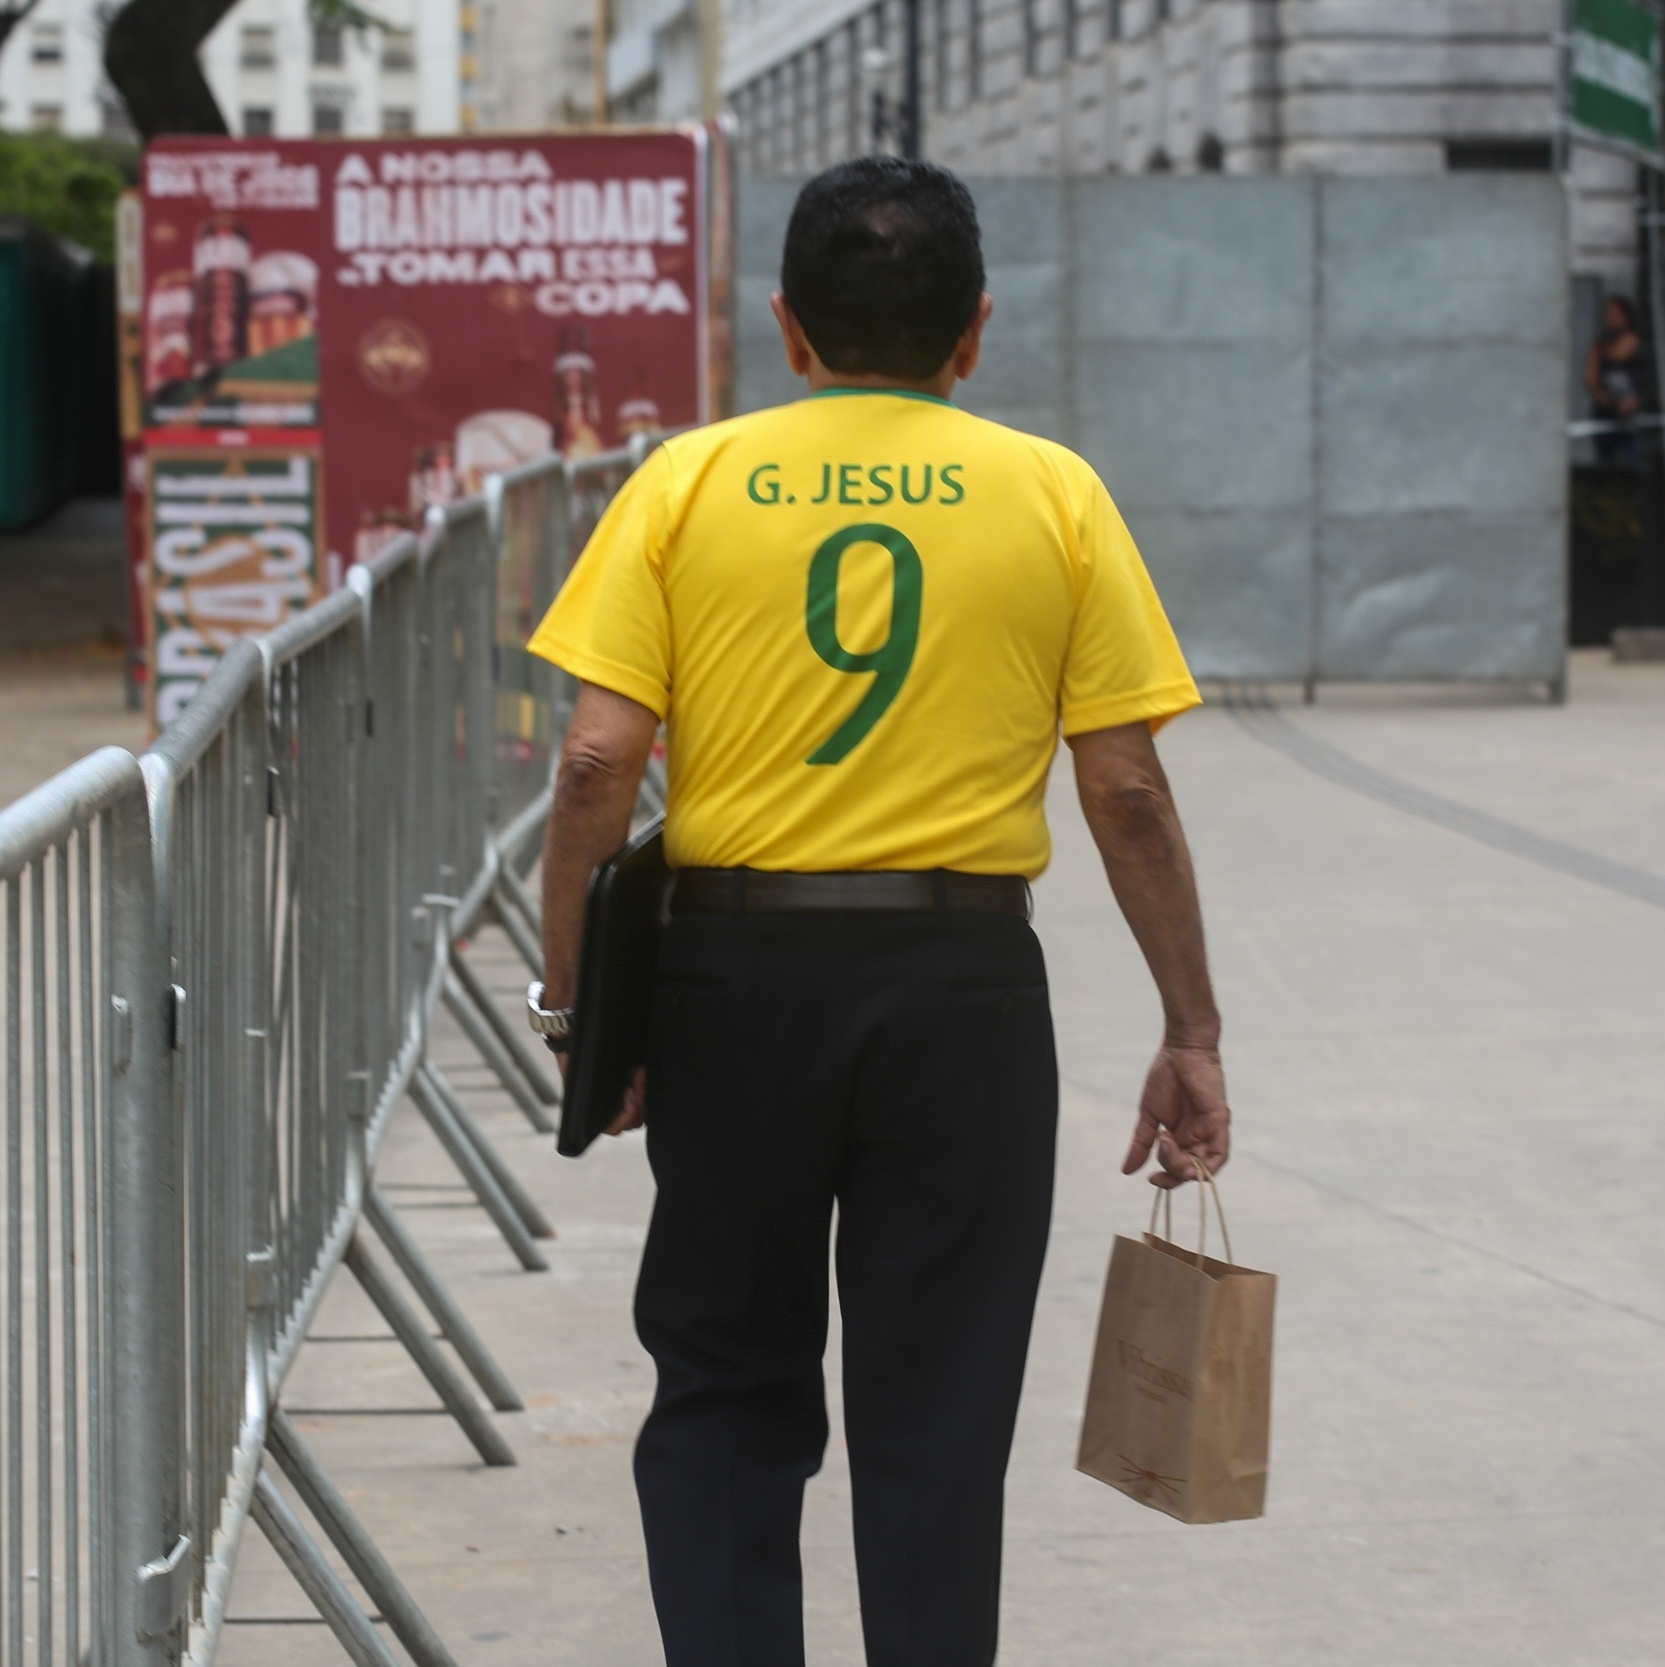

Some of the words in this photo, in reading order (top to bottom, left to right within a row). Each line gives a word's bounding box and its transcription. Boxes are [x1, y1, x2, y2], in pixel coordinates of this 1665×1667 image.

[336, 154, 373, 183] A
[380, 150, 551, 181] NOSSA
[334, 177, 688, 250] BRAHMOSIDADE
[352, 249, 556, 285] TOMAR
[562, 249, 657, 279] ESSA
[534, 280, 690, 315] COPA
[747, 463, 797, 506] G.
[811, 463, 966, 506] JESUS
[806, 523, 923, 765] 9
